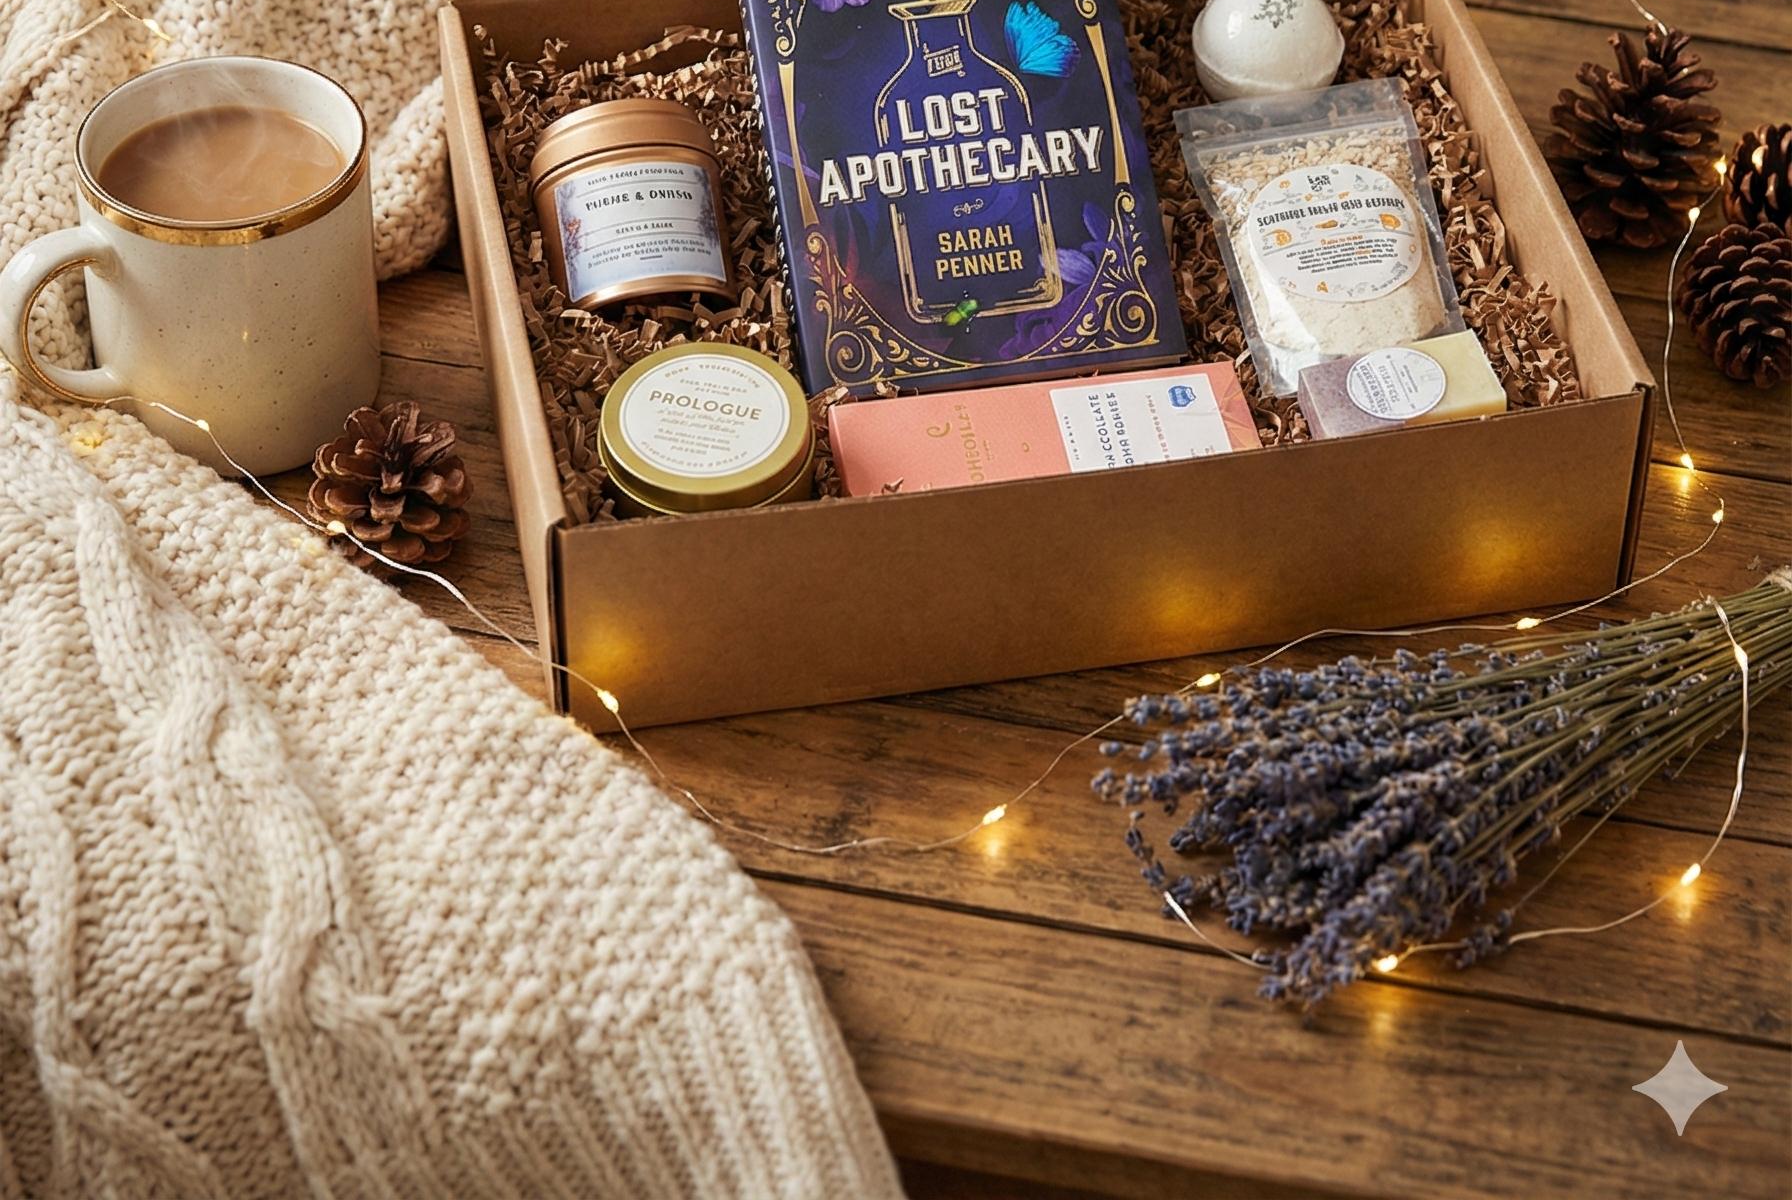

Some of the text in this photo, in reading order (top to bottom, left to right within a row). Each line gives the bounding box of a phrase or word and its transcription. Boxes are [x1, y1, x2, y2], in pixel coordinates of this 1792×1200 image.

[896, 87, 1008, 143] LOST
[819, 125, 1103, 207] APOTHECARY
[937, 224, 1014, 254] SARAH
[935, 249, 1023, 280] PENNER
[649, 390, 763, 421] PROLOGUE
